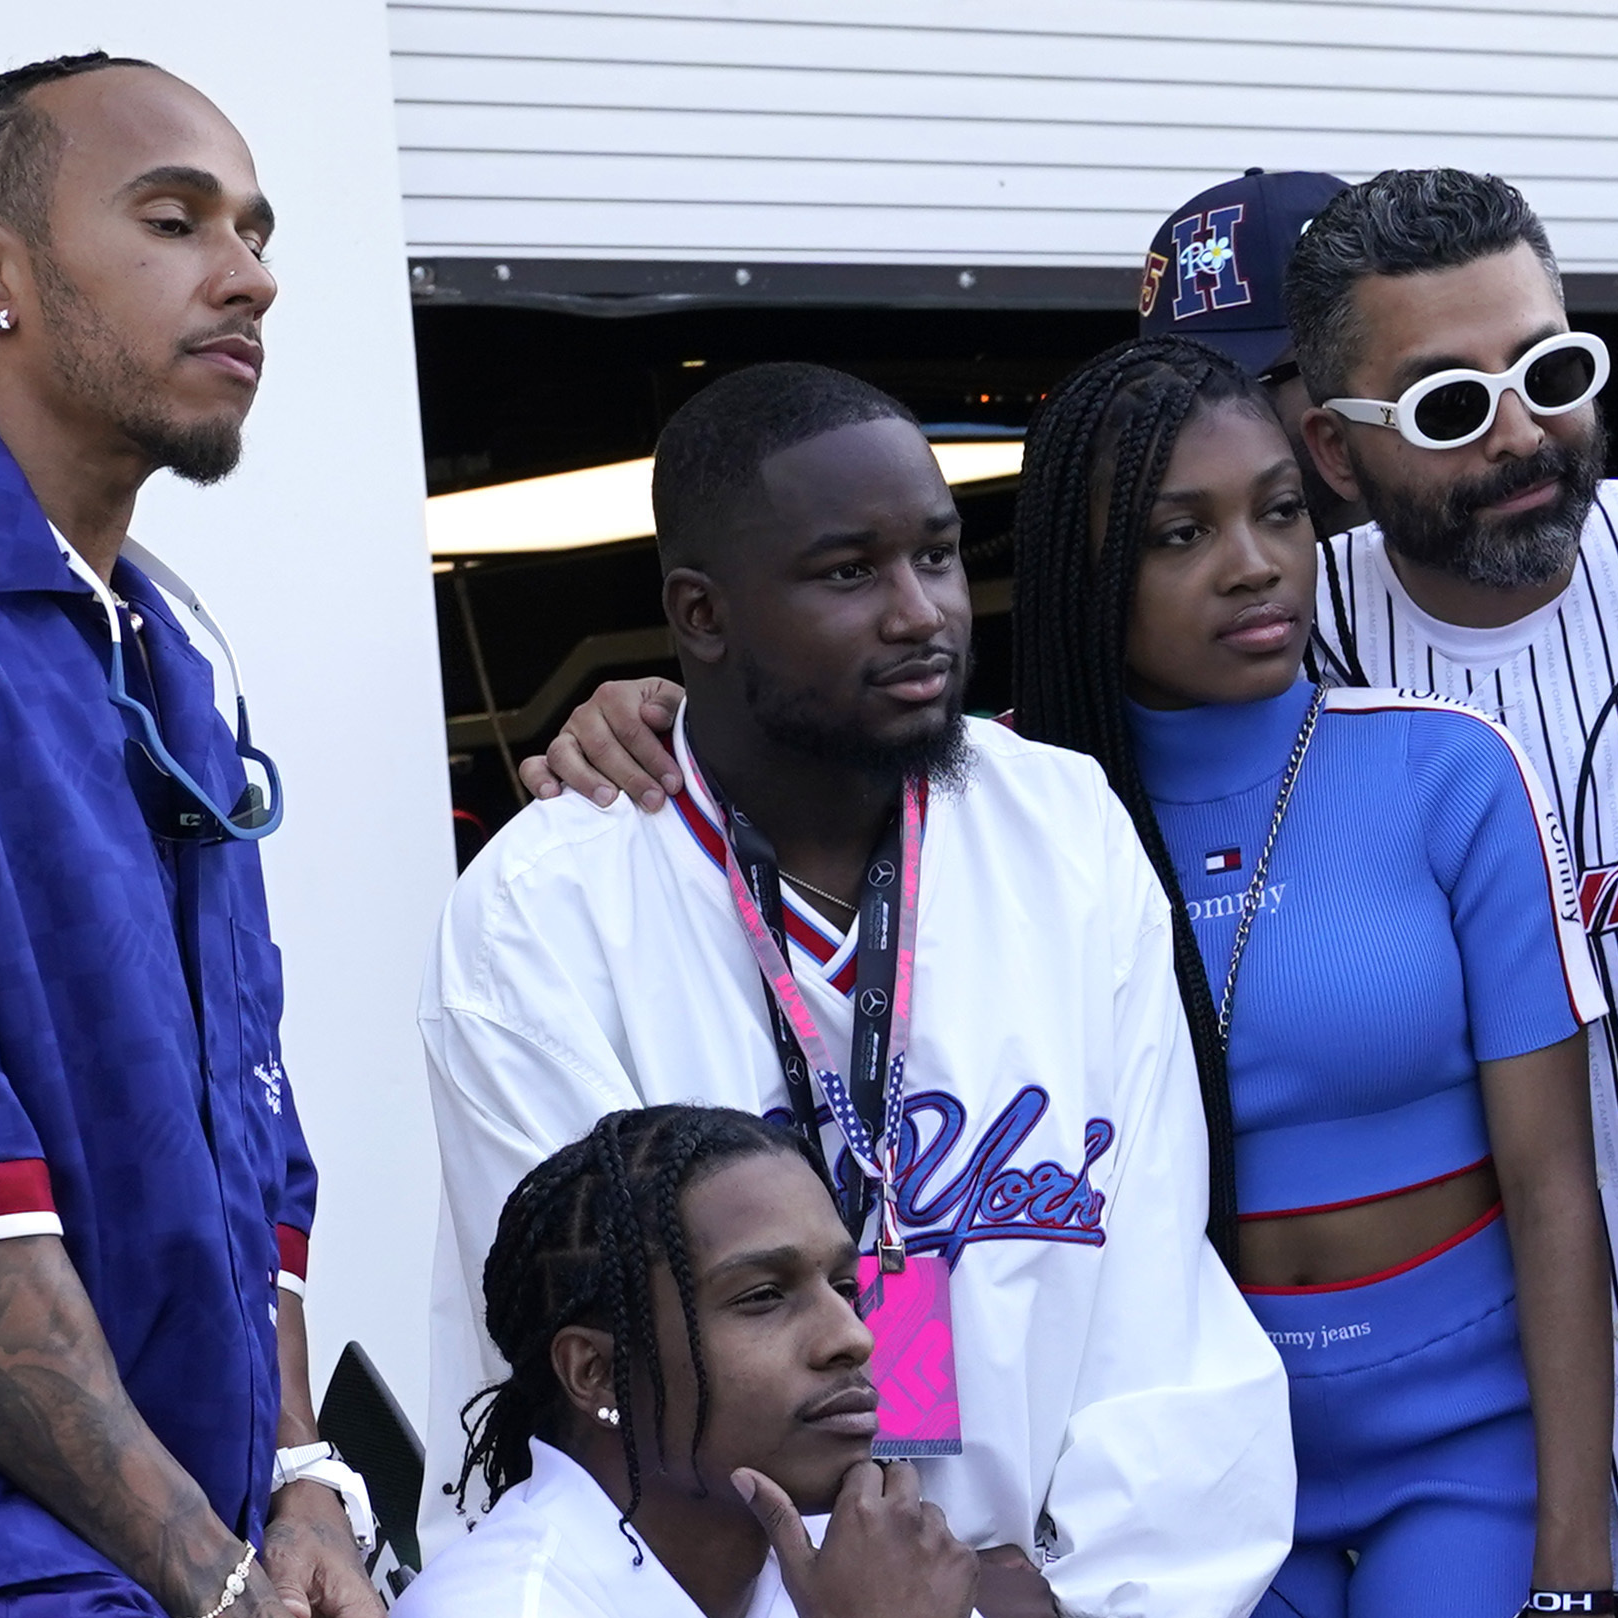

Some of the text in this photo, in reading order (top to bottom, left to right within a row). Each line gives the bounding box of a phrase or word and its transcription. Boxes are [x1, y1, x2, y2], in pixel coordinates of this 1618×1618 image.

[1172, 204, 1252, 321] H
[1545, 811, 1581, 924] tommy
[1321, 1322, 1372, 1348] jeans
